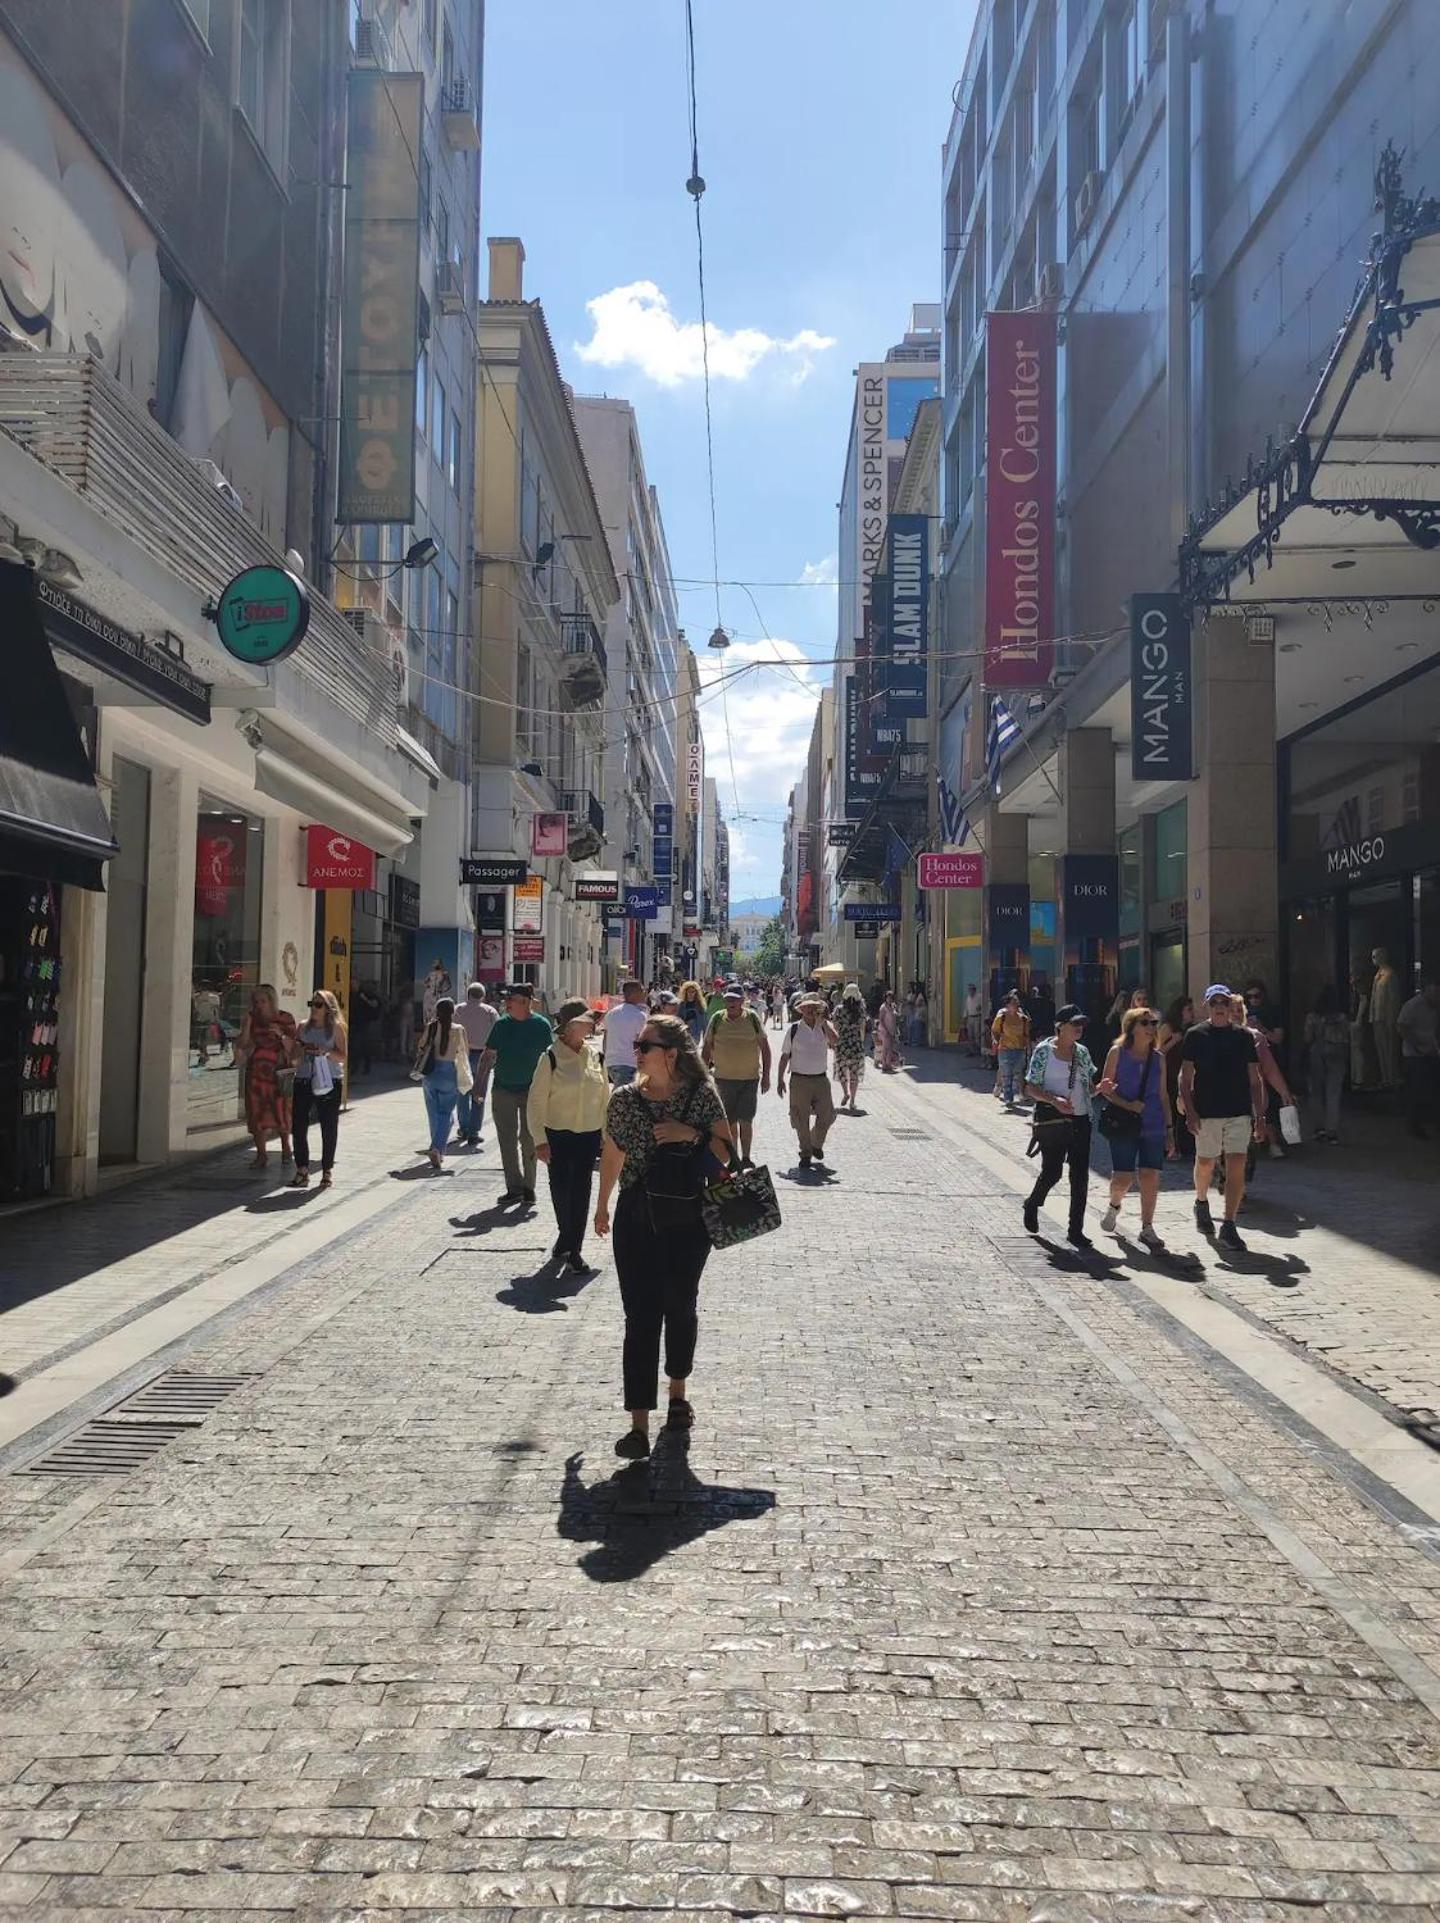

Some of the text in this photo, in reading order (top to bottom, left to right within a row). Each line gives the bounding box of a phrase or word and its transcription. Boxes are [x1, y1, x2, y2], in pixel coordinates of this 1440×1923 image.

[863, 377, 883, 492] SPENCER
[864, 496, 882, 512] &
[1000, 340, 1039, 663] Hondos Center
[893, 532, 922, 599] DUNK
[893, 603, 922, 666] SLAM
[1141, 609, 1169, 763] MANGO
[1175, 671, 1184, 703] MAN
[925, 858, 978, 872] Hondos
[1327, 836, 1385, 873] MANGO
[468, 864, 520, 880] Passager
[925, 871, 972, 885] Center
[578, 884, 617, 894] FAMOUS
[1074, 884, 1108, 896] DIOR
[996, 906, 1024, 916] DIOR
